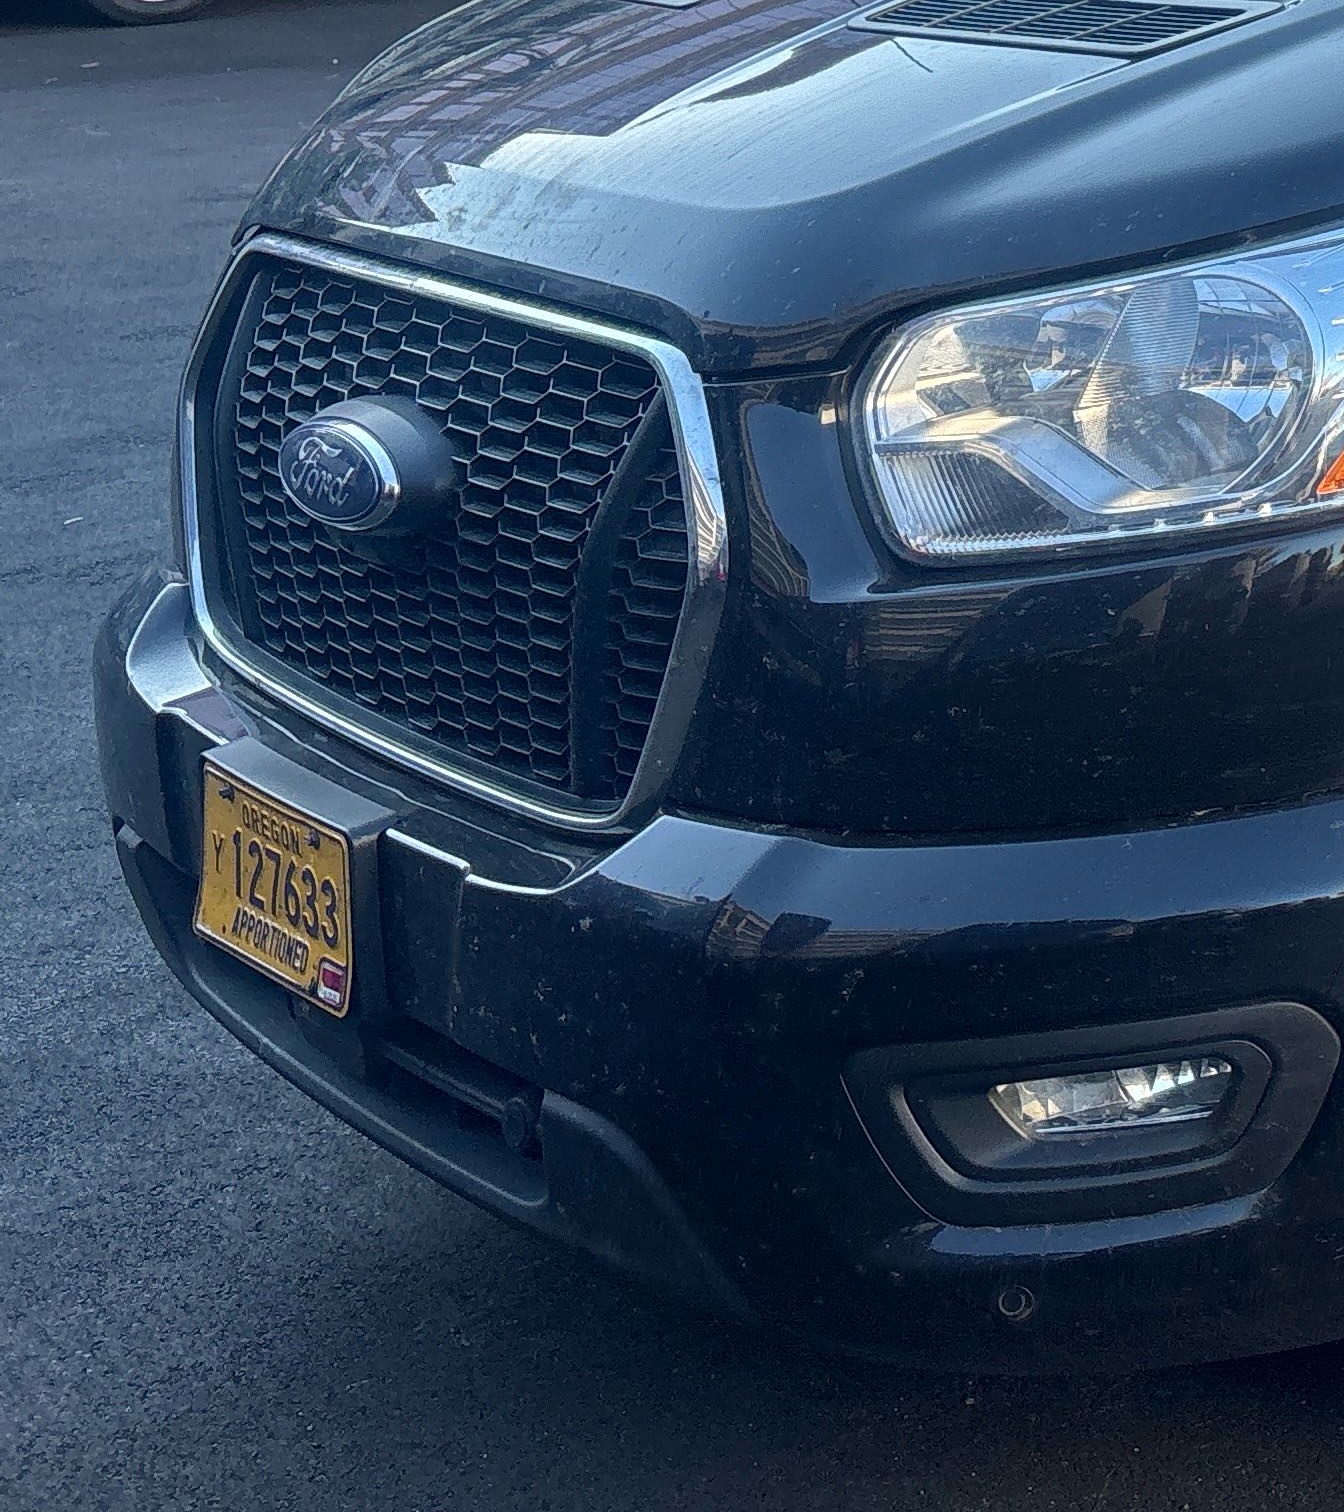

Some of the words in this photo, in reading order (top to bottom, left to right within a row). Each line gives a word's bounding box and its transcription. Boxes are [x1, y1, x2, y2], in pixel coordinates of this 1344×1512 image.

[290, 436, 354, 508] Ford
[241, 803, 303, 860] OREGON
[212, 829, 225, 874] Y
[232, 827, 339, 948] 127633
[232, 906, 310, 974] APPORTIONED
